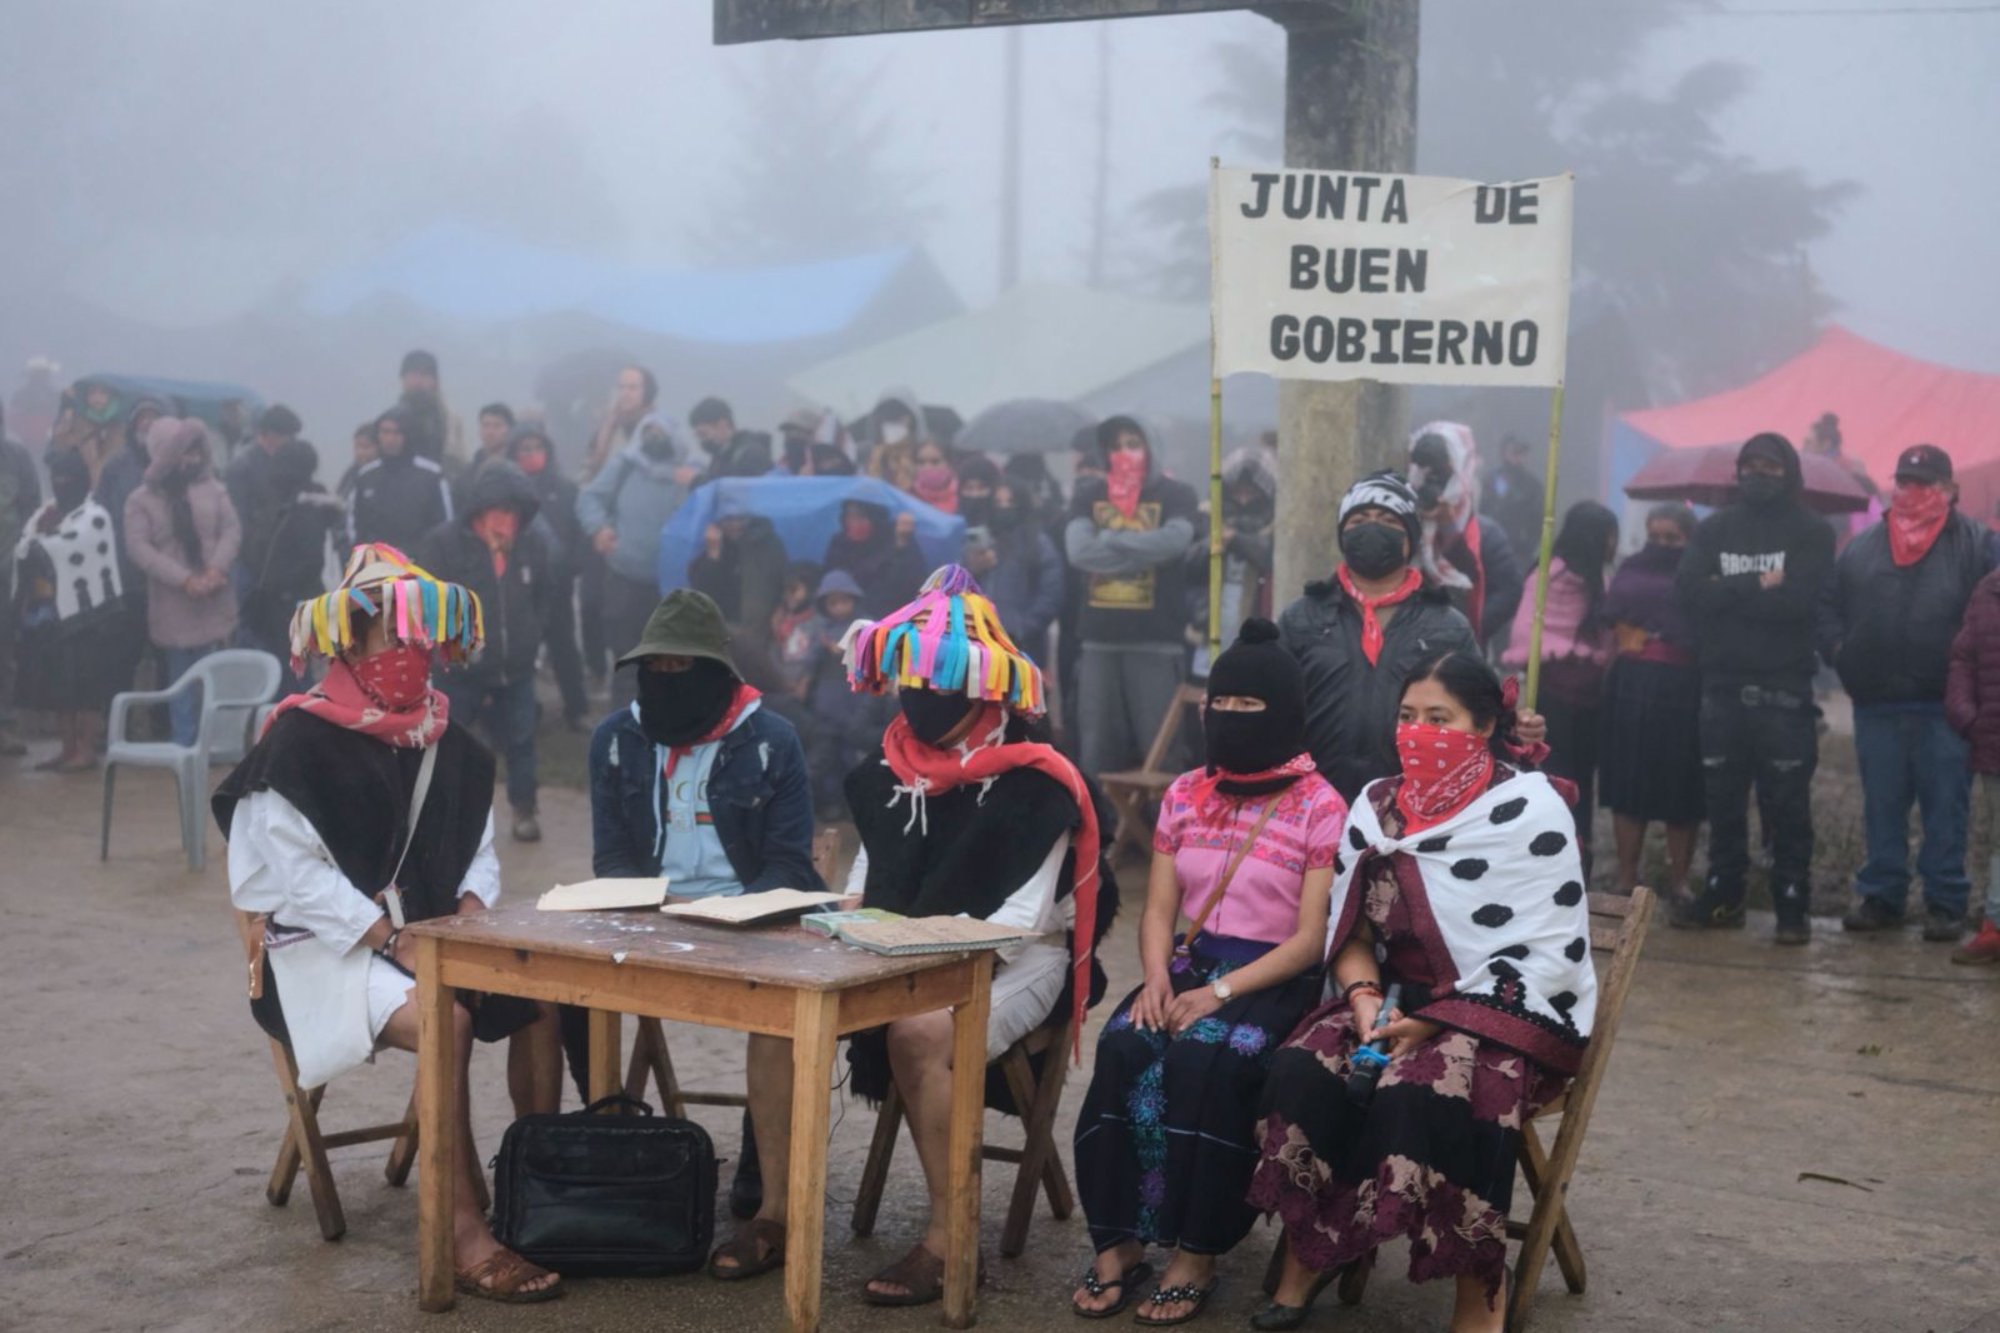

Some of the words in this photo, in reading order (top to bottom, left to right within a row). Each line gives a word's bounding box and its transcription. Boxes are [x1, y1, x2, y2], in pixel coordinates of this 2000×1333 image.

[1240, 173, 1408, 224] JUNTA
[1475, 183, 1539, 225] DE
[1290, 245, 1428, 293] BUEN
[1270, 314, 1539, 366] GOBIERNO
